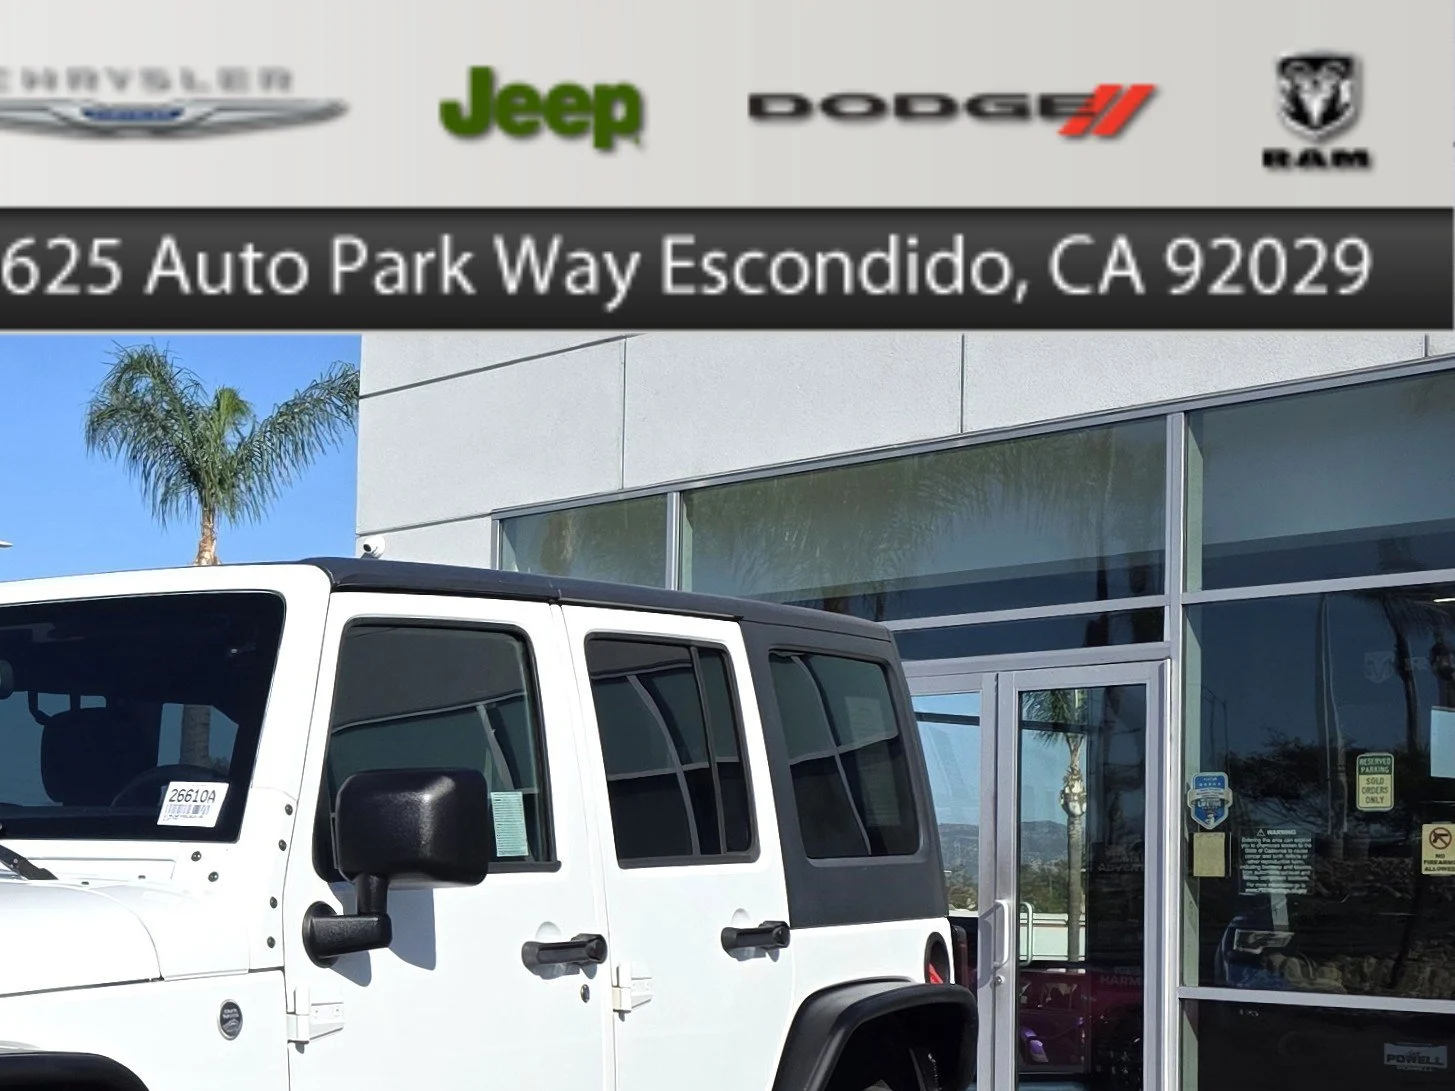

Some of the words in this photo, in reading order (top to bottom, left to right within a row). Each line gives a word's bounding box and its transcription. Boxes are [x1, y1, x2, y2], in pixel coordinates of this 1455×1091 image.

[1366, 776, 1385, 785] SOLD
[168, 788, 217, 804] 26610A
[1365, 796, 1385, 804] ONLY
